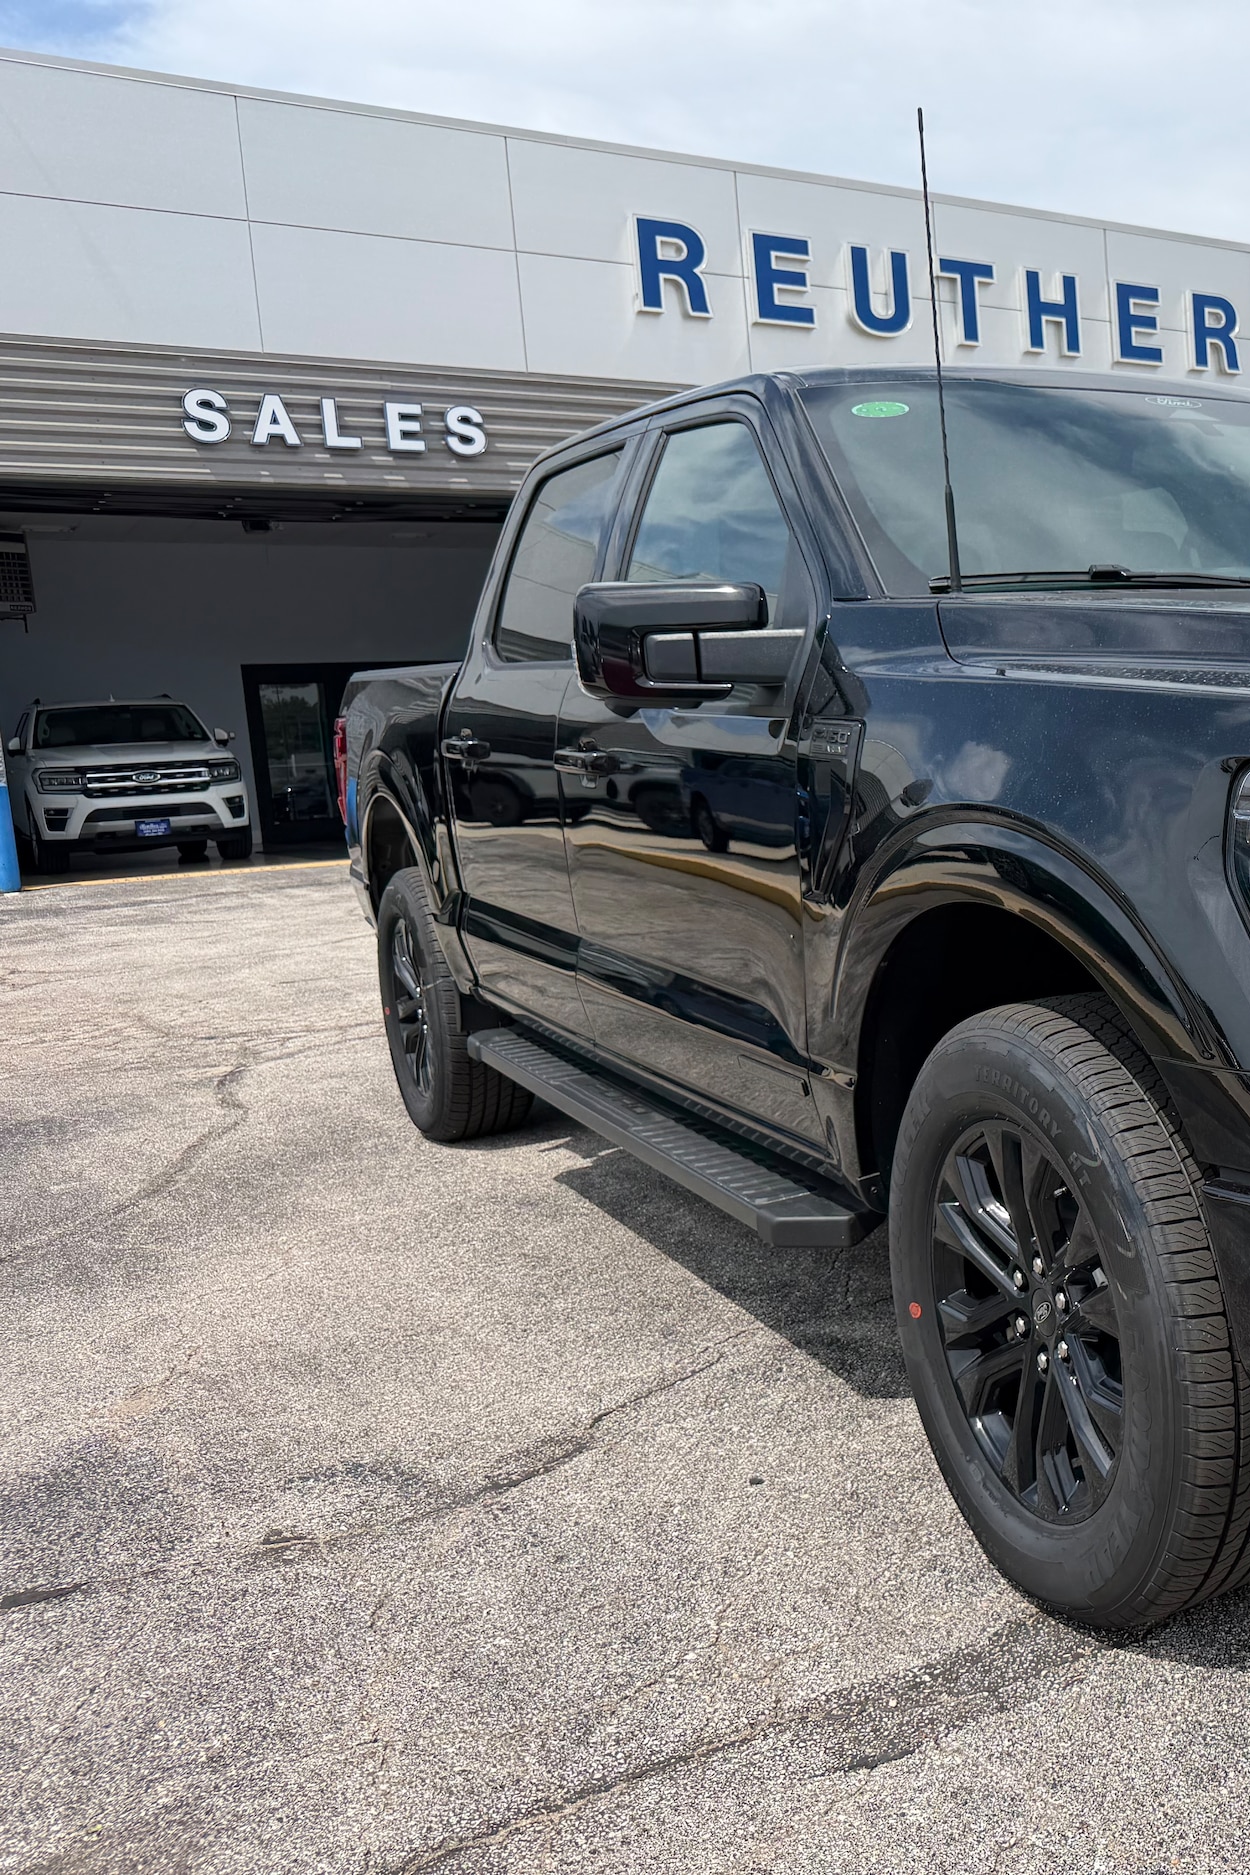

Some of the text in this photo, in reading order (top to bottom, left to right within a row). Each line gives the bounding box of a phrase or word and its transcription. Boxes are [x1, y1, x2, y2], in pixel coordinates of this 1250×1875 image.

[634, 213, 1242, 375] REUTHER
[181, 387, 489, 457] SALES
[974, 1063, 1063, 1138] TERRITORY
[1067, 1151, 1092, 1187] HT
